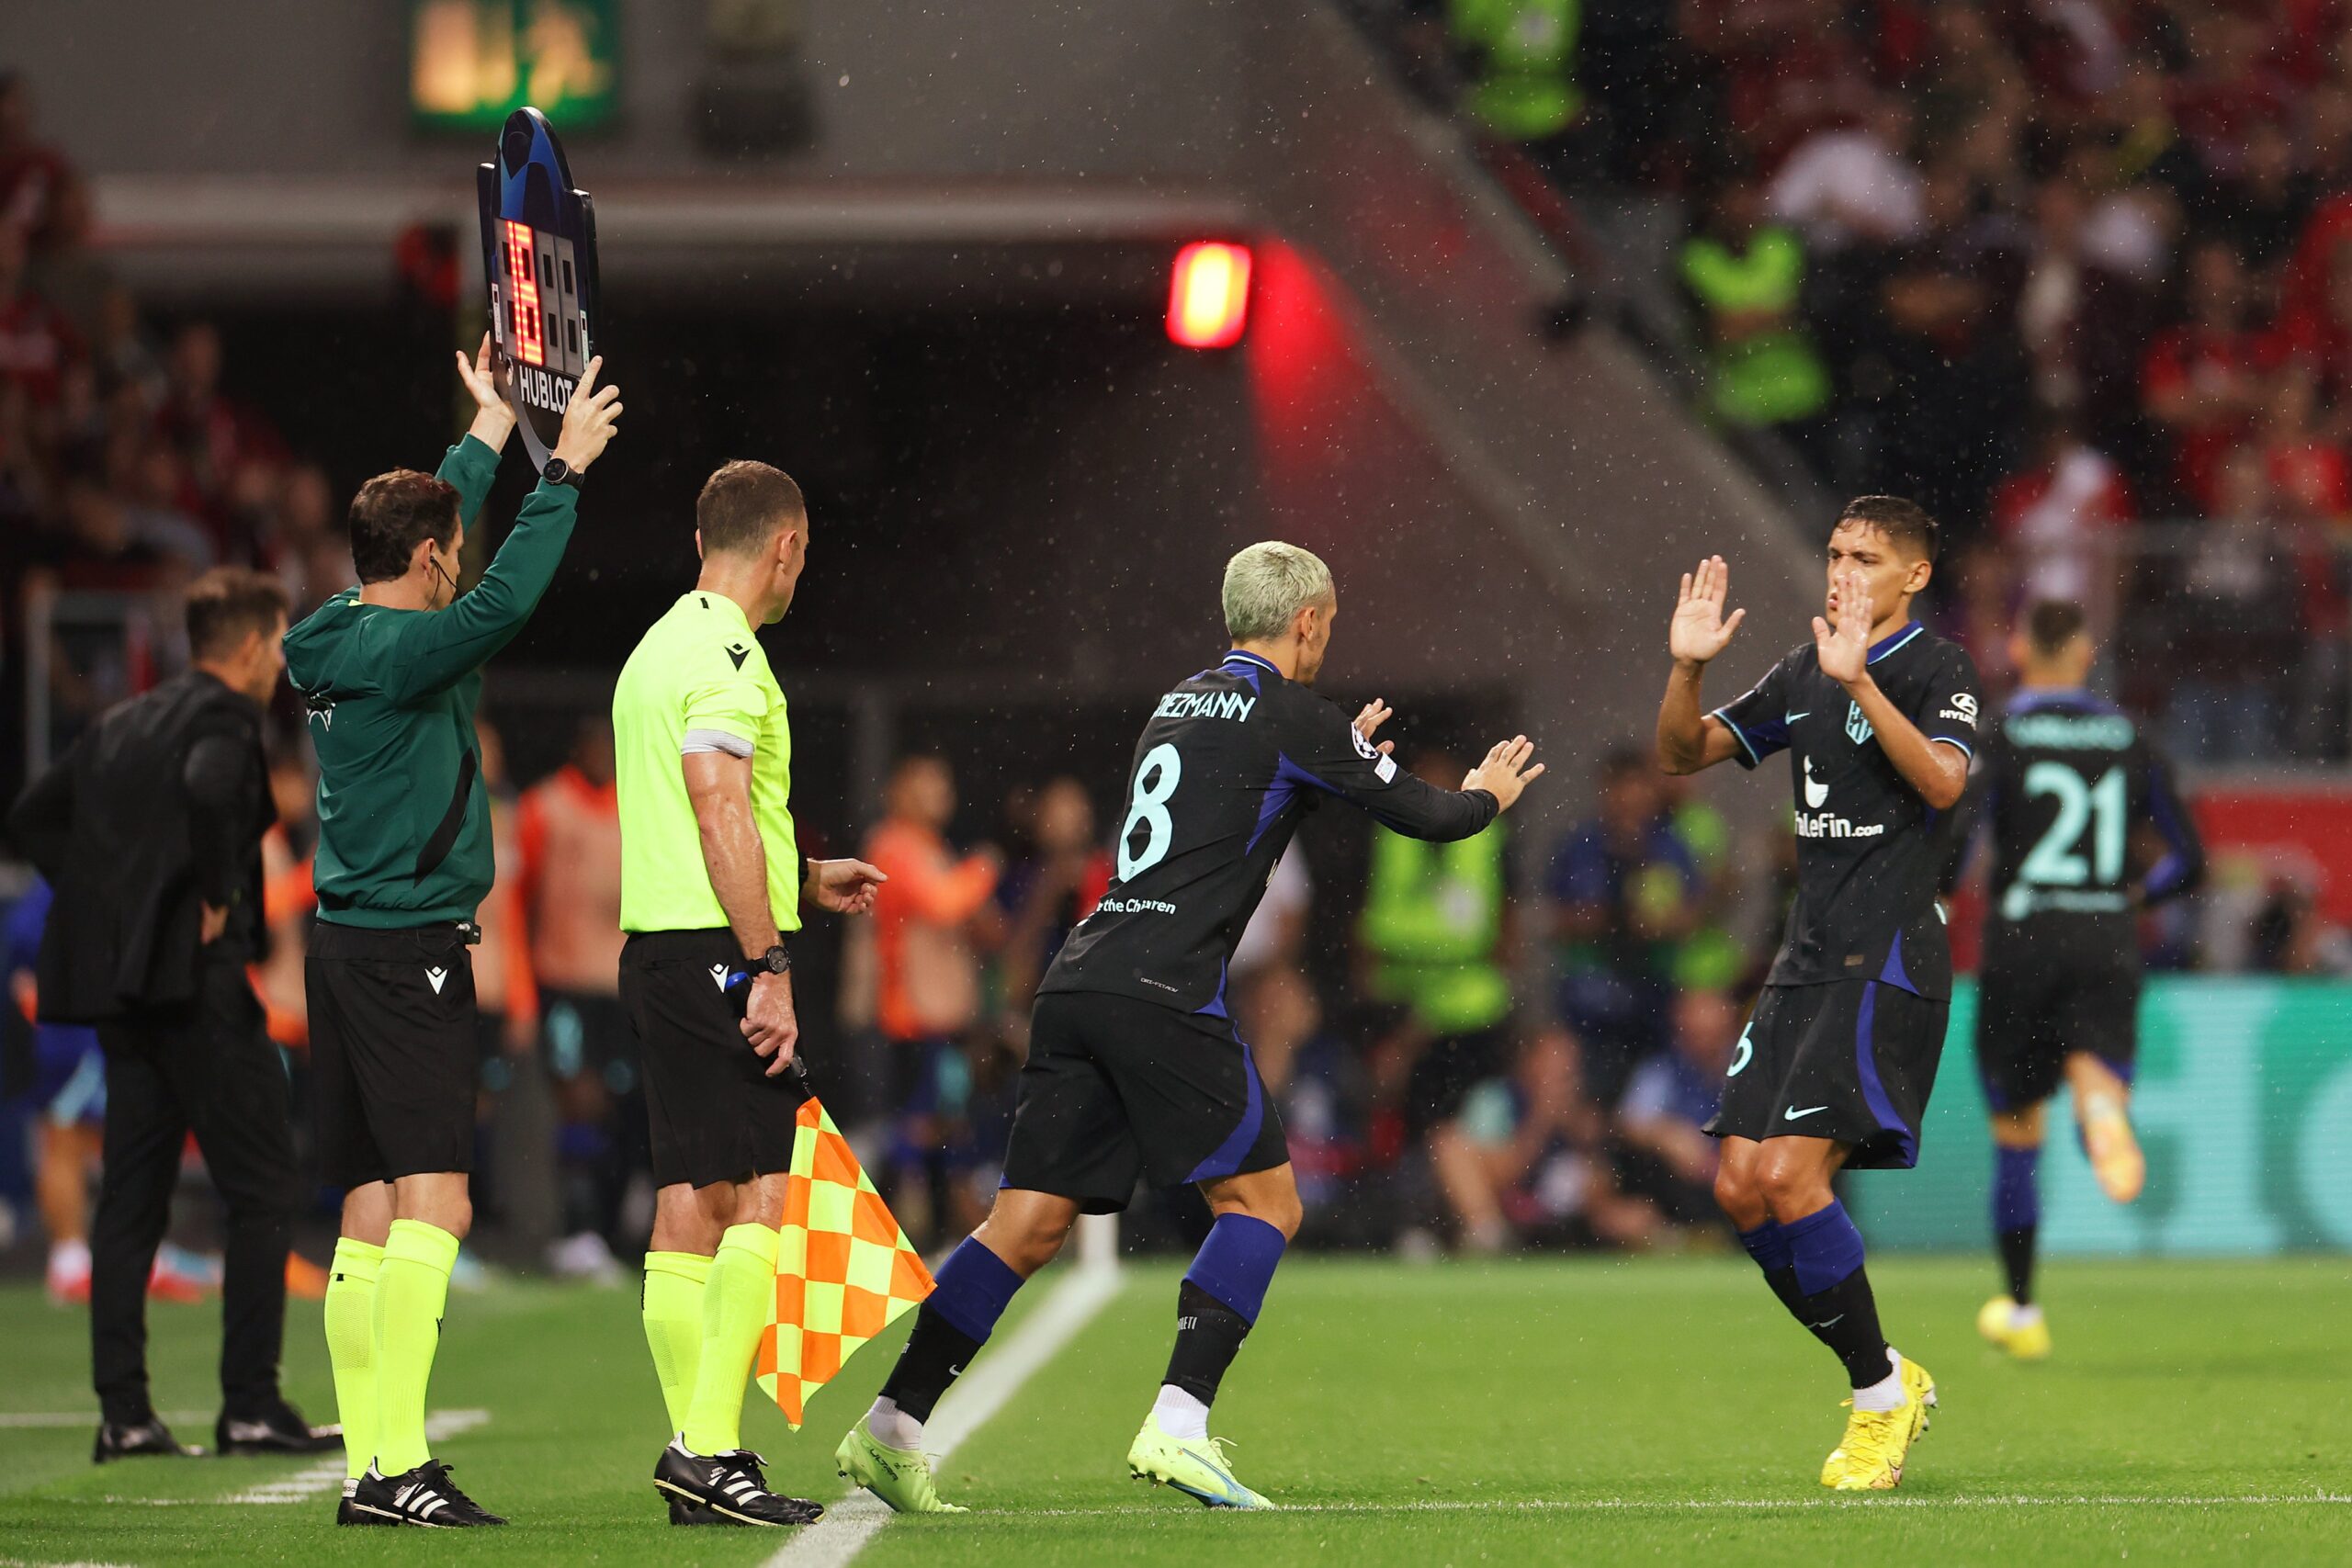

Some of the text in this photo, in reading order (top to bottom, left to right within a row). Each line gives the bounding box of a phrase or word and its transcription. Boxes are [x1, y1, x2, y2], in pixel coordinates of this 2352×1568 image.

[519, 365, 573, 415] HUBLOT
[1150, 691, 1257, 723] RIEZMANN
[1117, 742, 1182, 884] 8
[2020, 761, 2128, 888] 21
[1102, 898, 1177, 915] the Chiren
